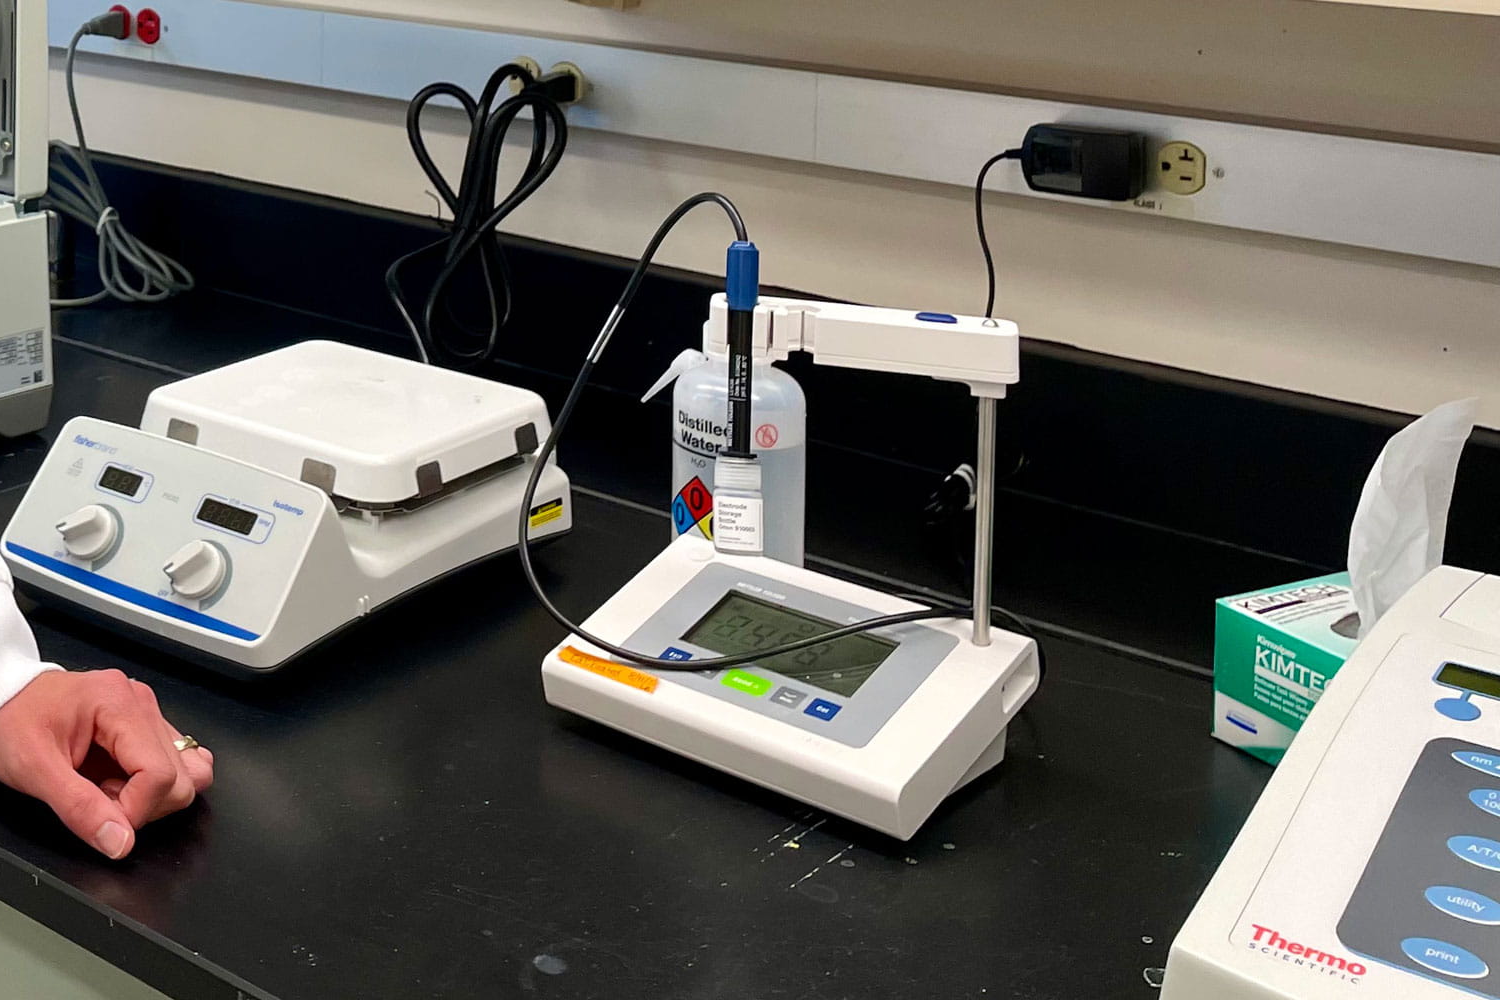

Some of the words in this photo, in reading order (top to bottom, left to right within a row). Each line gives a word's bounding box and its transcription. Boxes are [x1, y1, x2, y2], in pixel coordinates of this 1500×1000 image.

[73, 434, 118, 456] fisherbrand
[681, 428, 722, 454] Water
[273, 500, 304, 516] Isotemp
[690, 486, 704, 511] 0
[718, 501, 748, 511] Electrode
[675, 502, 685, 527] 0
[718, 509, 742, 519] Storage
[718, 517, 736, 525] Bottle
[815, 704, 830, 715] Cal
[1470, 755, 1493, 767] nm
[1446, 894, 1487, 913] utility
[1251, 923, 1367, 977] Thermo
[1424, 947, 1461, 966] print
[1248, 942, 1361, 986] SCIENTIFIC
